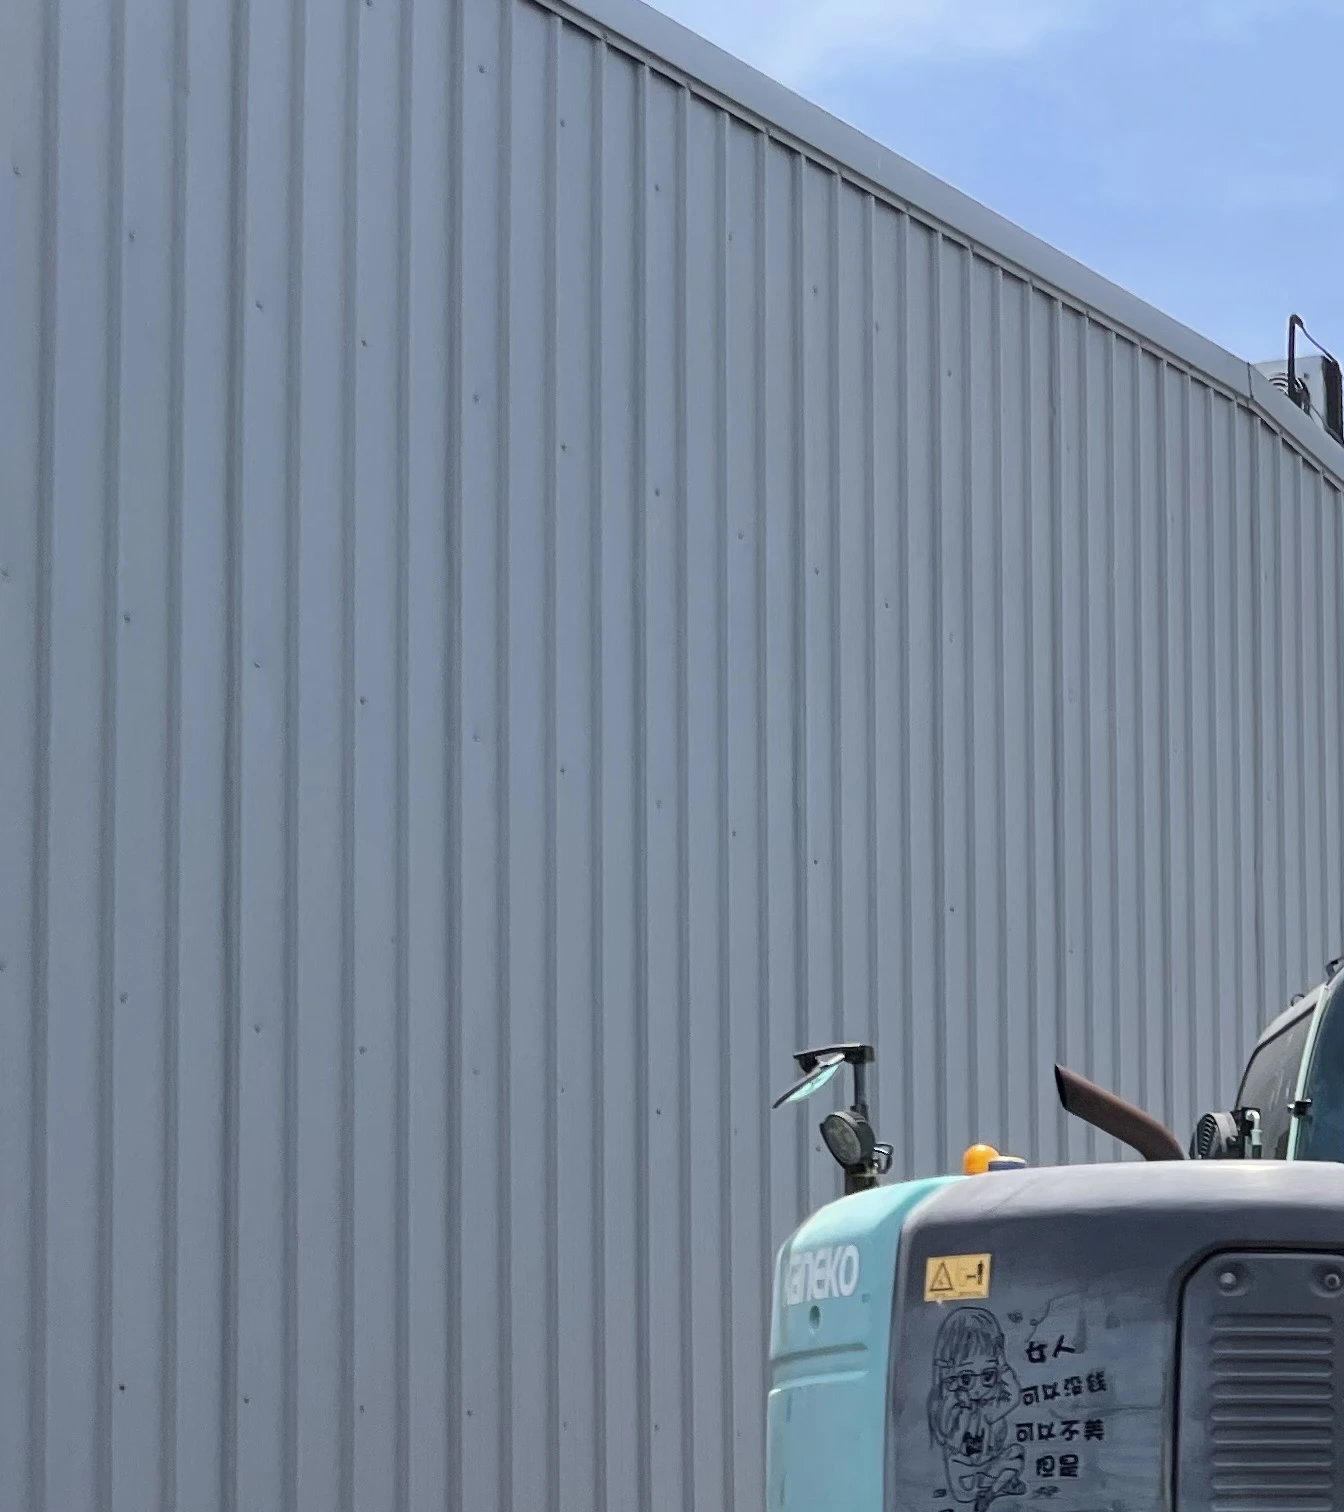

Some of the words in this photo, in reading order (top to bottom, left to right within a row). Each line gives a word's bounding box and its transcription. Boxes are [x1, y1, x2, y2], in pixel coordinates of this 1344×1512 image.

[1025, 1334, 1077, 1363] 女人
[1016, 1419, 1105, 1442] 可以不美
[1036, 1454, 1079, 1478] 但是
